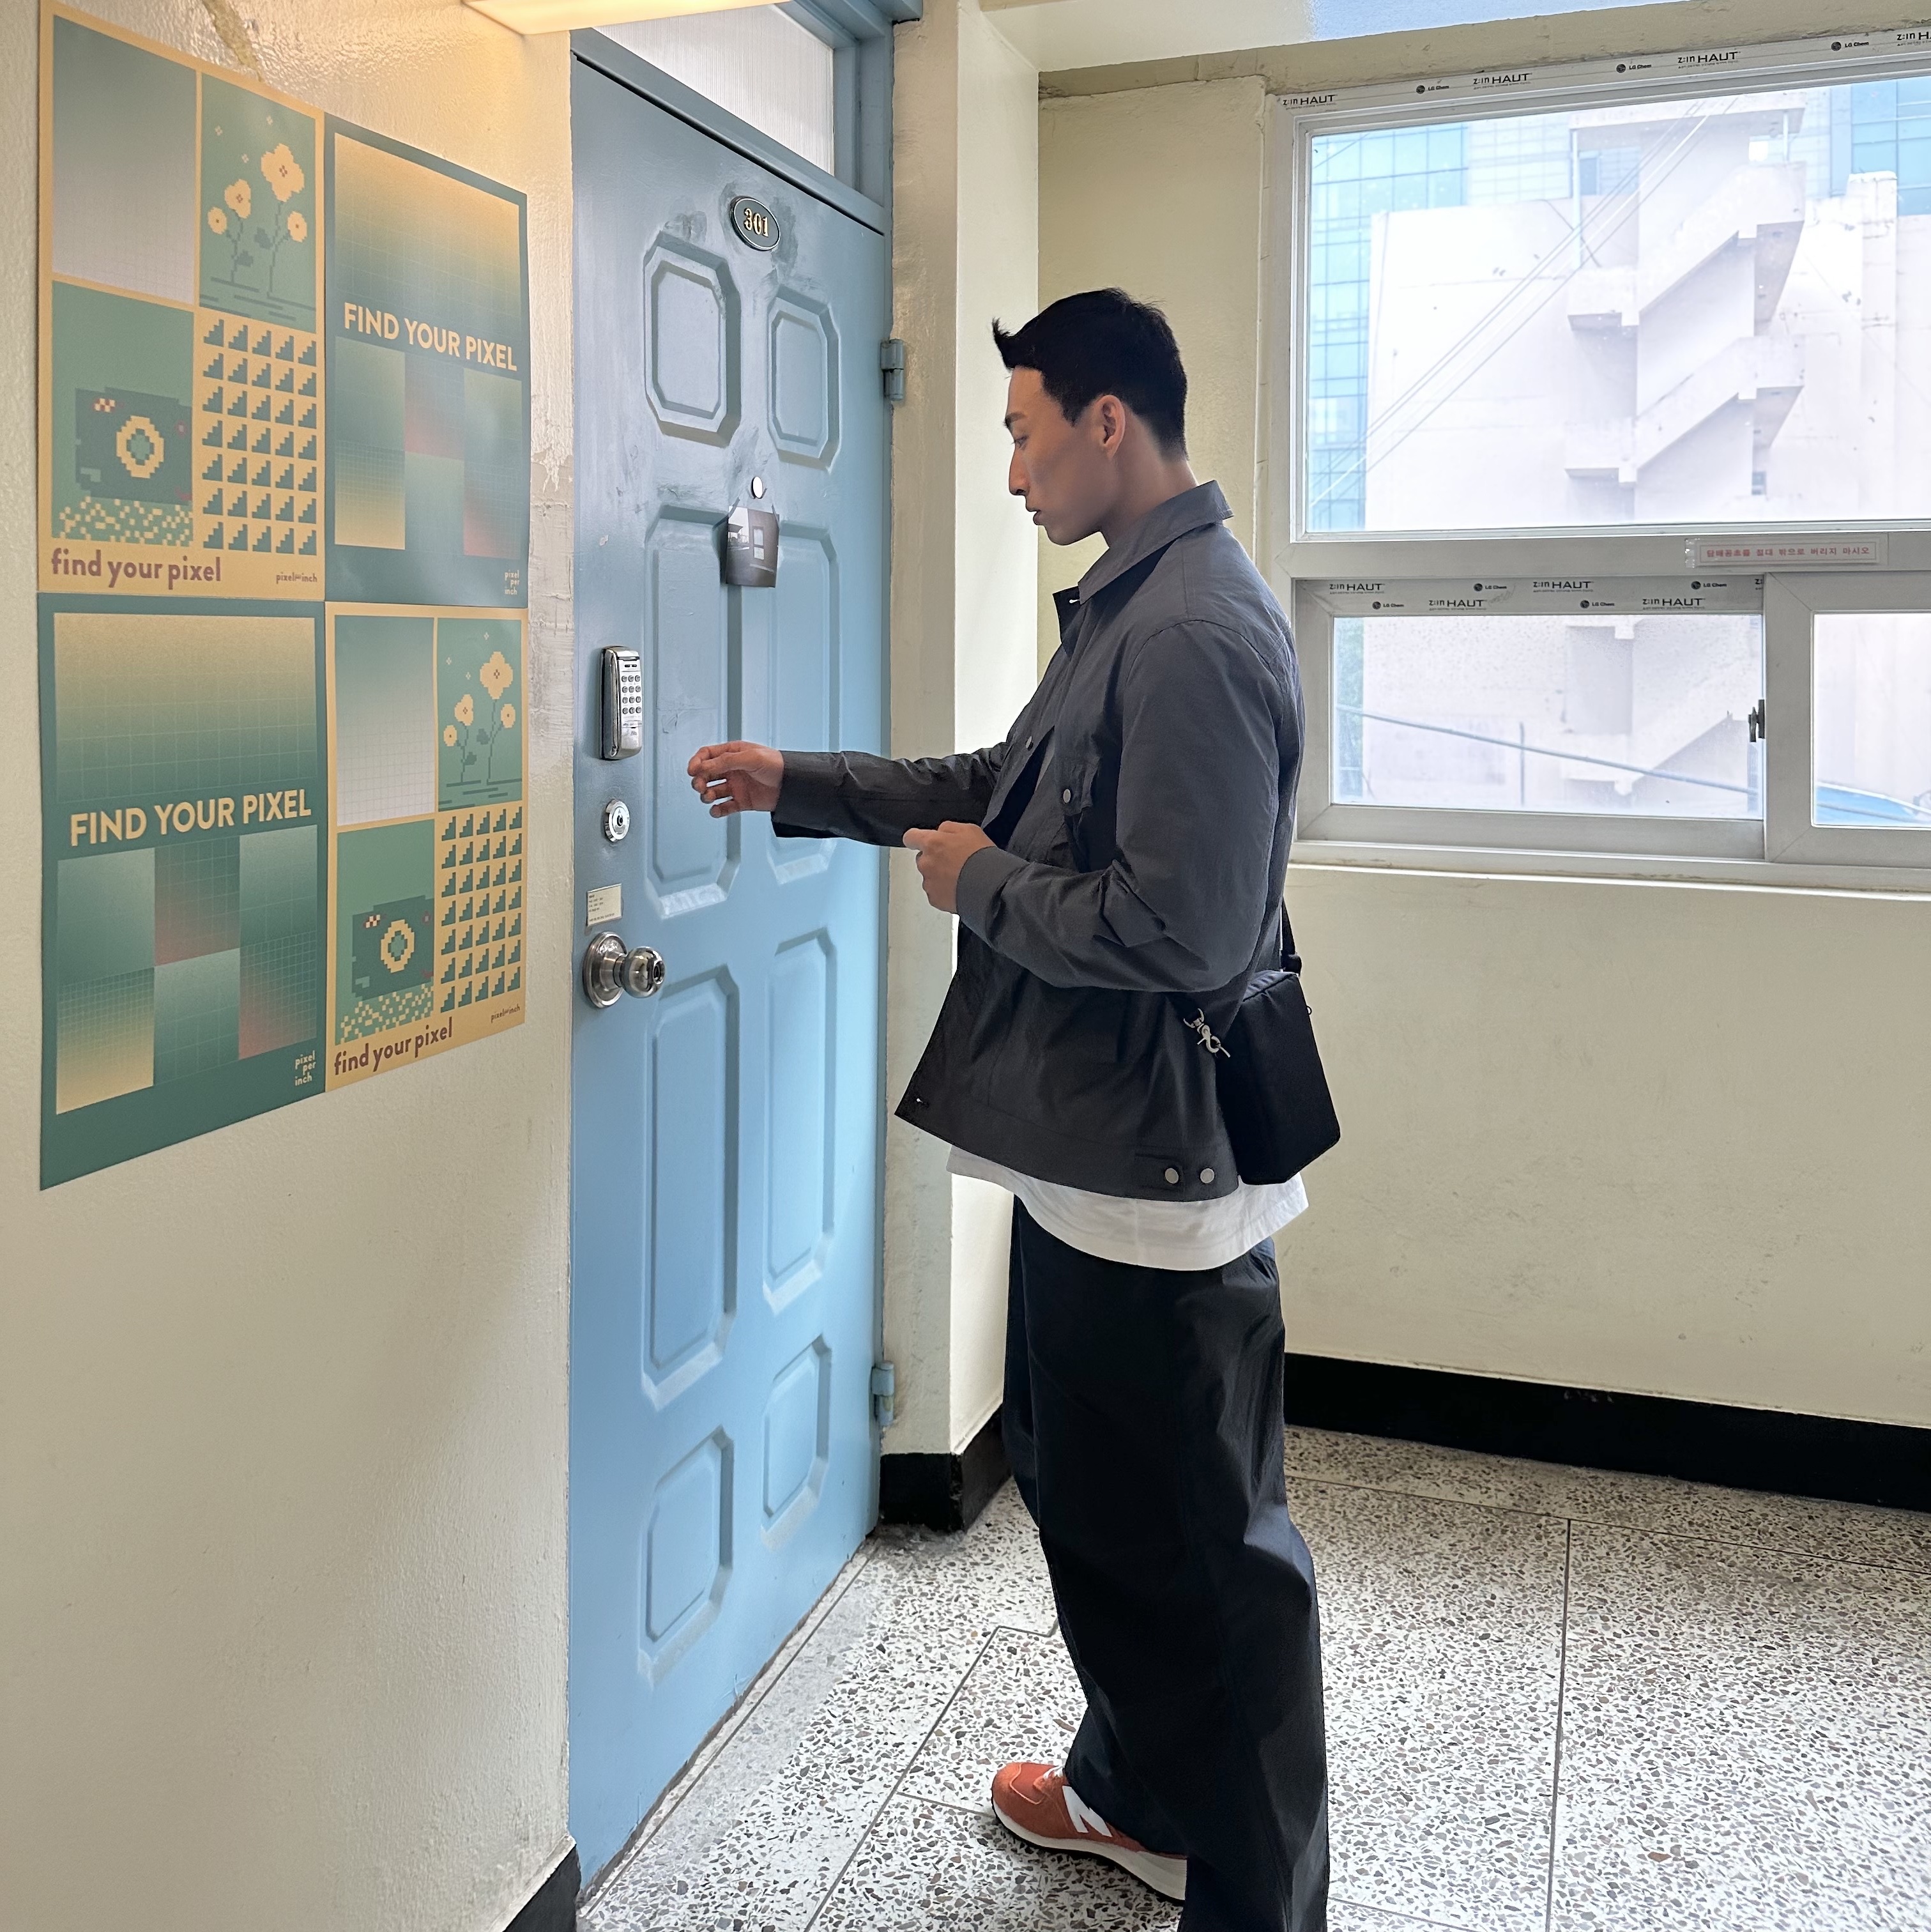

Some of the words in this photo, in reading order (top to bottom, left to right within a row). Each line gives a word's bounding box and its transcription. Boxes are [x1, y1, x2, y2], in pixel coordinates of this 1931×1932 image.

[1918, 31, 1931, 40] H
[1698, 51, 1738, 63] HAUT
[1492, 73, 1530, 84] HAUT
[1300, 94, 1336, 105] HAUT
[744, 208, 769, 238] 301
[344, 302, 400, 340] FIND
[404, 318, 461, 358] YOUR
[466, 335, 517, 371] PIXEL
[1757, 548, 1773, 556] 절대
[1779, 548, 1806, 556] 밖으로
[1811, 547, 1837, 555] 버리지
[1842, 546, 1870, 555] 마시오
[51, 547, 102, 576] find
[107, 561, 163, 588] your
[168, 555, 221, 590] pixel
[505, 569, 519, 581] pixel
[1552, 581, 1591, 589] HAUT
[70, 807, 147, 847] FIND
[154, 797, 235, 835] YOUR
[243, 788, 312, 824] PIXEL
[334, 1042, 369, 1075] find
[372, 1038, 412, 1072] your
[415, 1016, 452, 1058] pixel
[295, 1050, 316, 1070] pixel
[303, 1061, 316, 1075] per
[294, 1071, 312, 1086] inch
